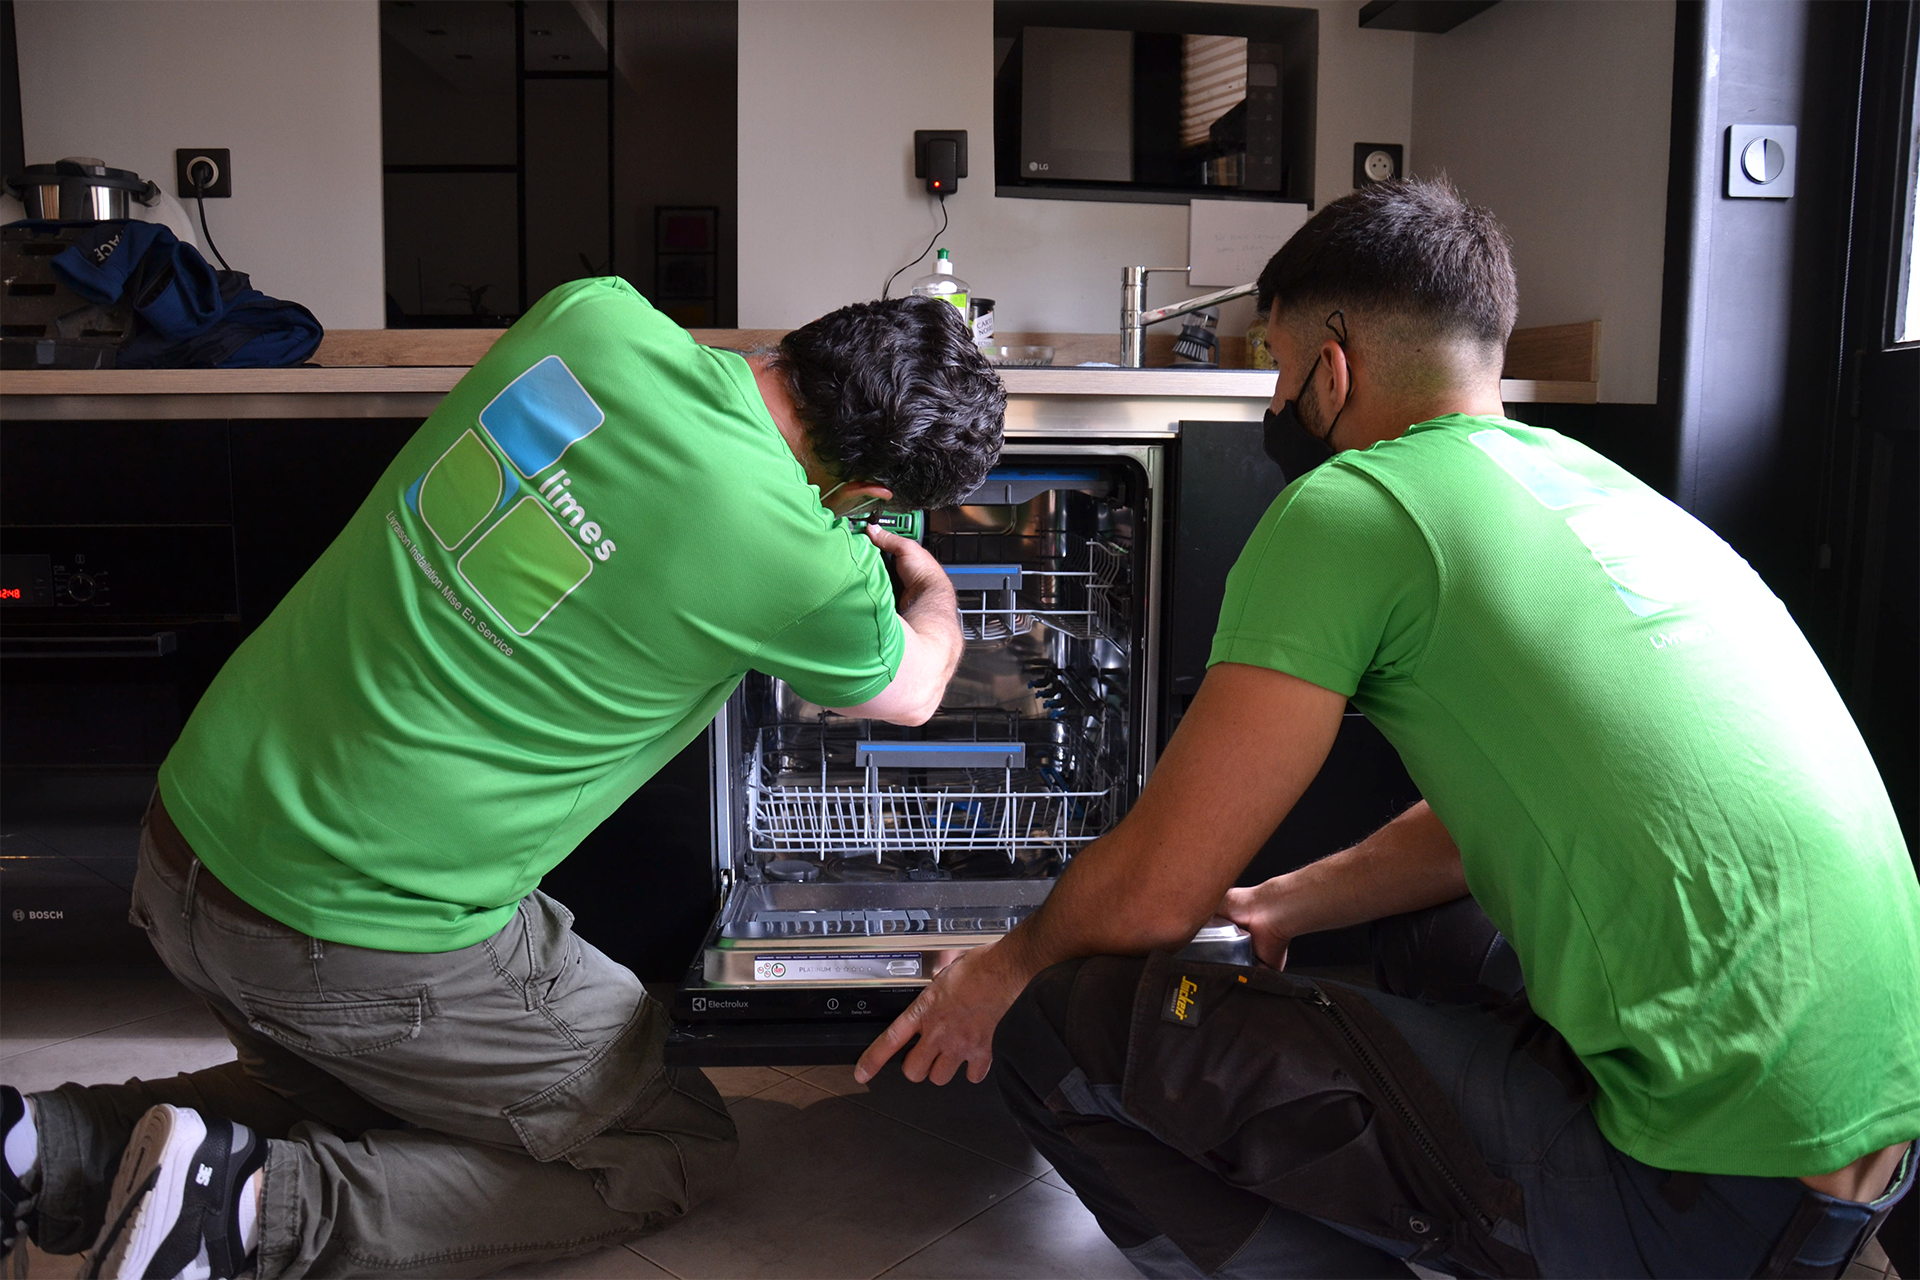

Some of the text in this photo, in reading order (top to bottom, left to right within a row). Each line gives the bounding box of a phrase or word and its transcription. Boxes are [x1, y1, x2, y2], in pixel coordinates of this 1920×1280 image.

[94, 230, 124, 262] ACE
[538, 468, 617, 561] limes
[385, 510, 514, 656] Livraison Installation Mise En Service
[29, 910, 64, 919] BOSCH
[708, 1000, 749, 1008] Electrolux
